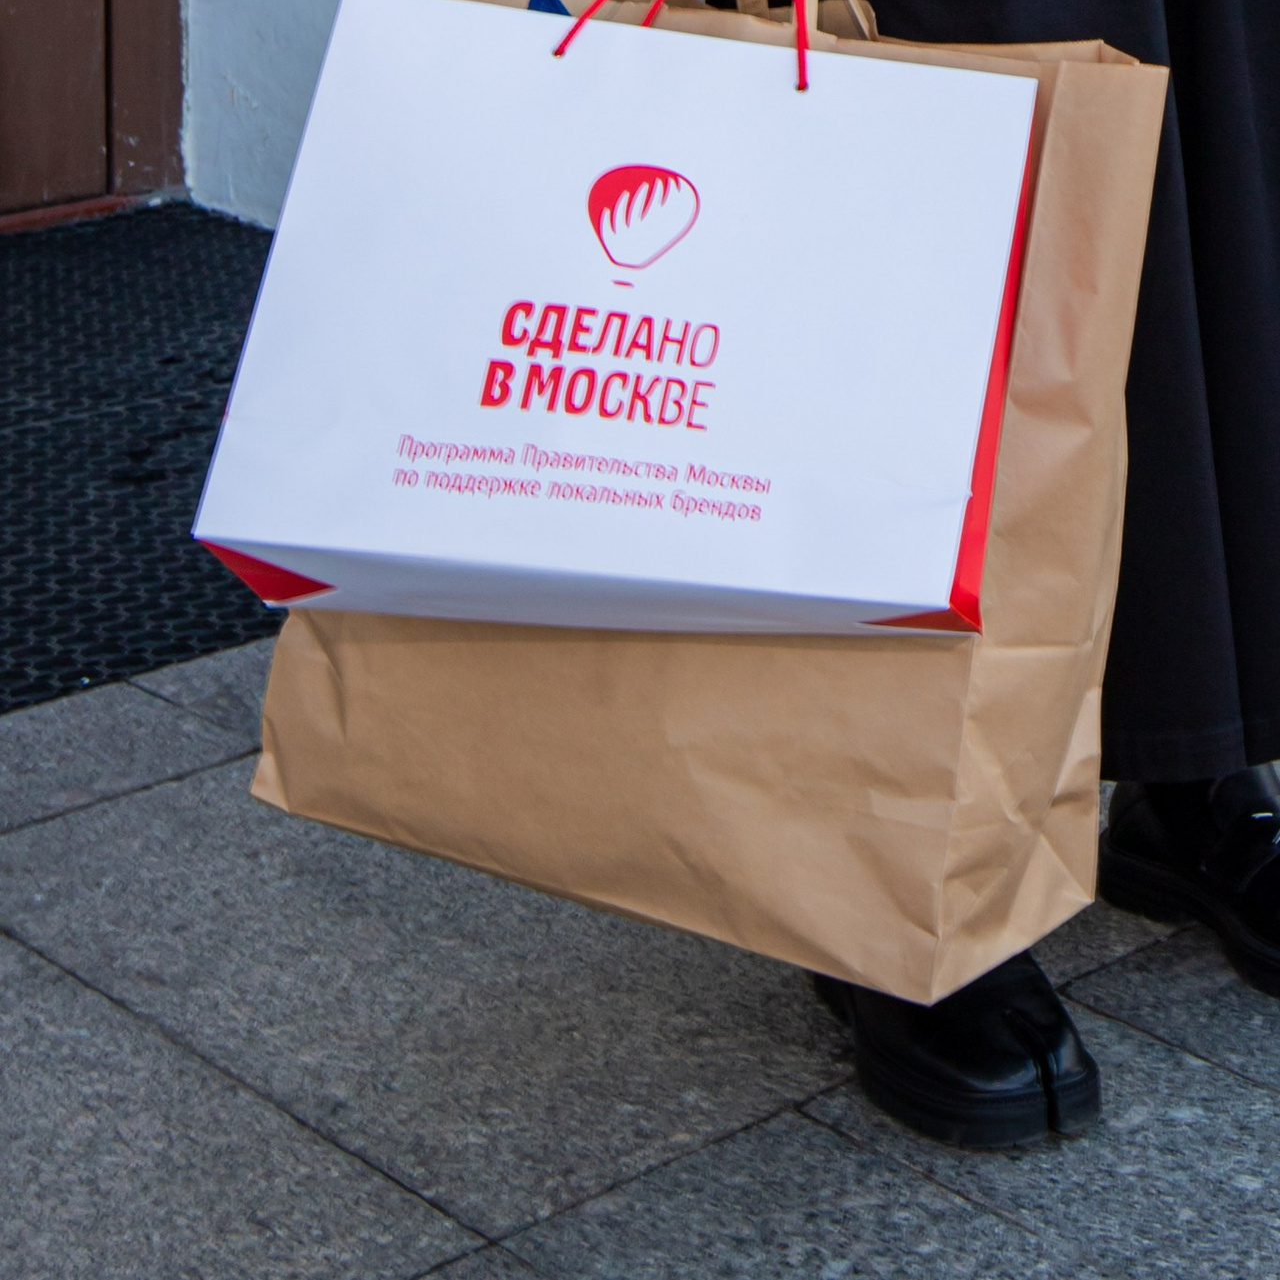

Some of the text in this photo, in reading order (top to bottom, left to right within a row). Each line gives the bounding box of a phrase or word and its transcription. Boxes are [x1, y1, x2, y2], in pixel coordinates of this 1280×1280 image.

[500, 299, 721, 369] СДЕЛАНО
[479, 359, 716, 431] В МОСКВЕ
[393, 467, 763, 523] по поддержке локальных брендов
[397, 434, 771, 495] Программа Правительства Москвы
